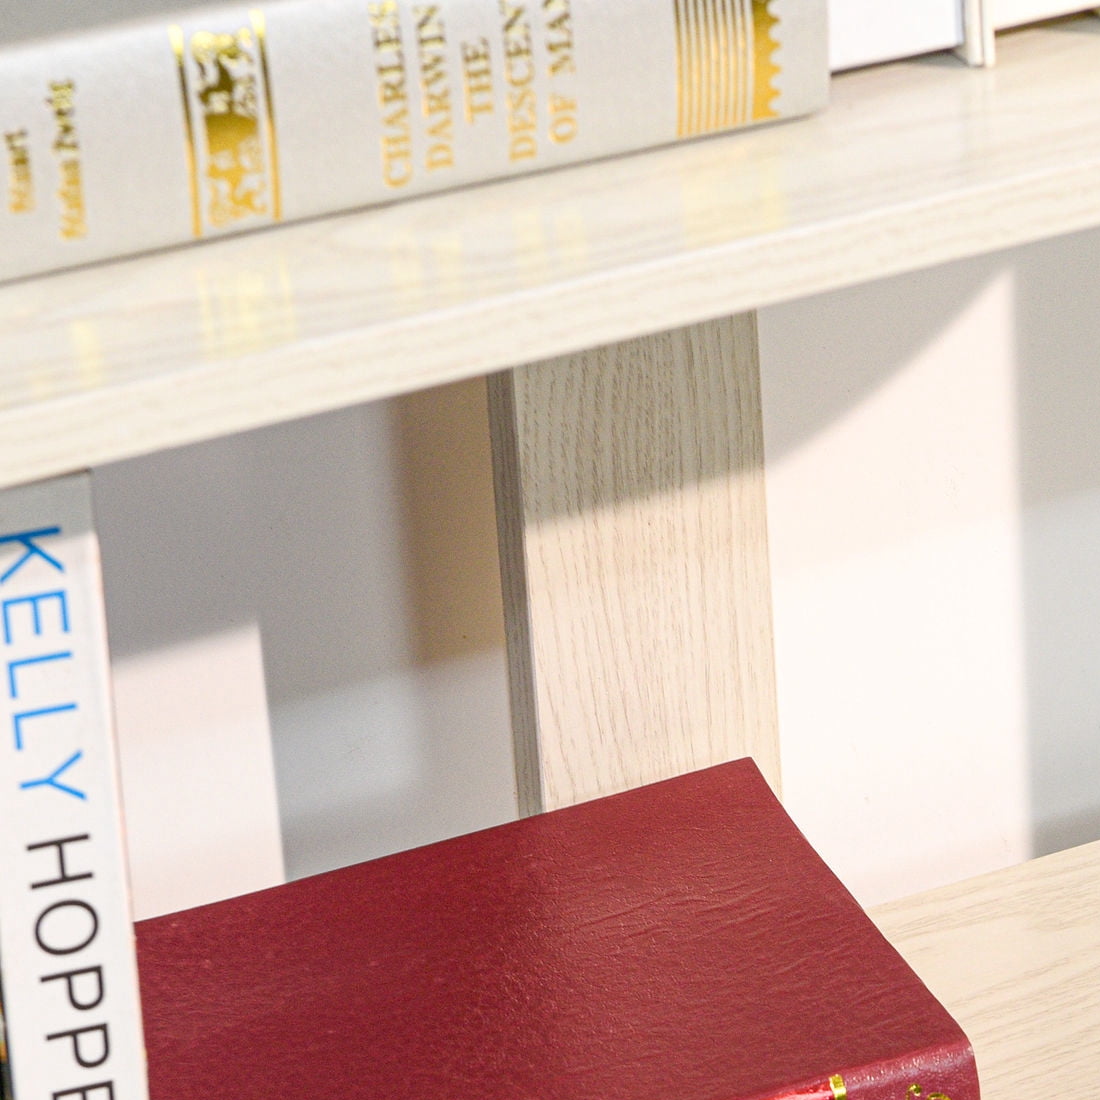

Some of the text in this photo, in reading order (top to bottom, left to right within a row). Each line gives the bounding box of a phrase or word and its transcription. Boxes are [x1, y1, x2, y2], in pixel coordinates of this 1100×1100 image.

[368, 0, 413, 189] CHARLES
[414, 4, 454, 173] DARWIN
[461, 36, 494, 125] THE
[498, 0, 538, 163] DESCEN
[548, 94, 580, 144] OF
[0, 525, 87, 800] KELLY
